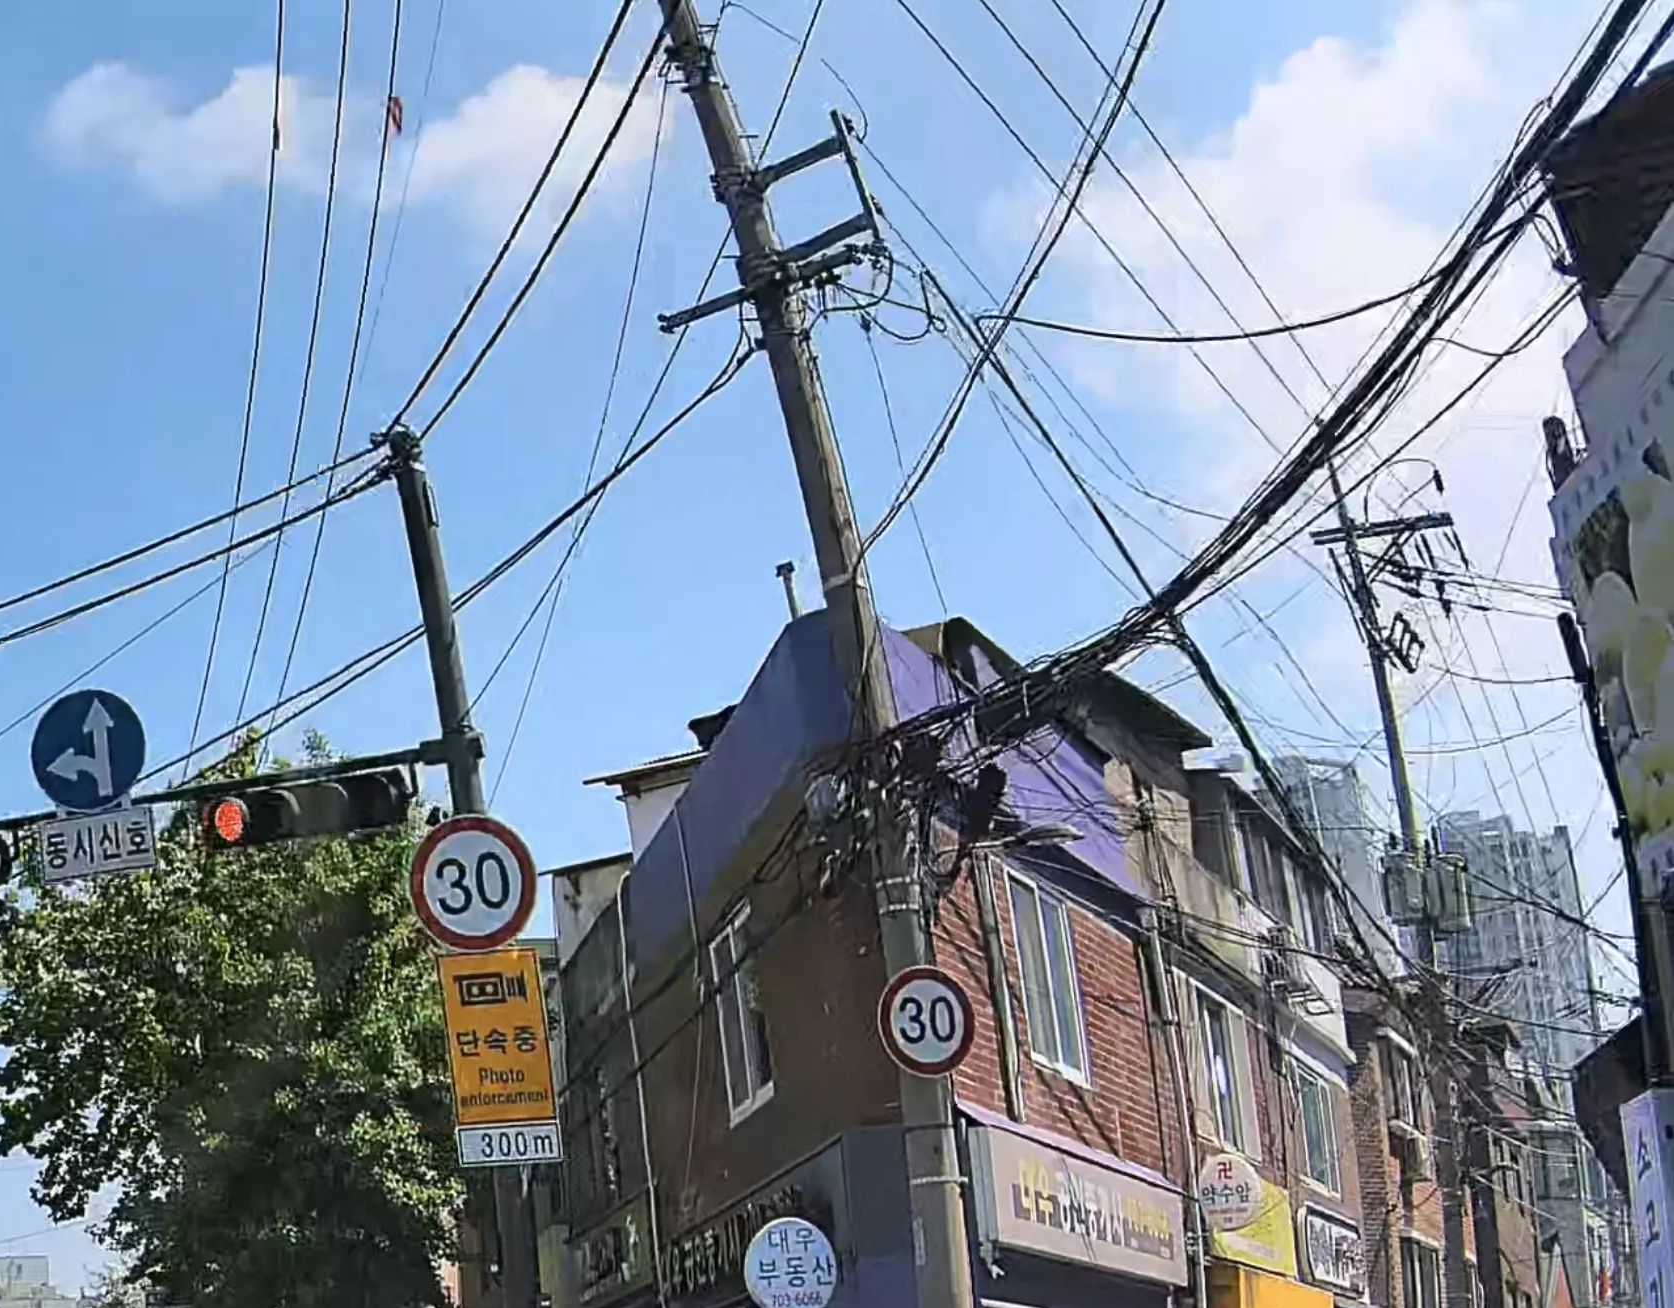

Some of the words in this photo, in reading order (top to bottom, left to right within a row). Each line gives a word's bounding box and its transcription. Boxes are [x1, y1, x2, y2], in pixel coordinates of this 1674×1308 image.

[46, 821, 150, 869] 동시신호
[436, 852, 510, 915] 30
[899, 996, 956, 1044] 30
[456, 1025, 537, 1057] 단속중
[479, 1067, 525, 1086] Photo
[481, 1132, 553, 1158] 300m
[768, 1227, 816, 1255] 대우
[758, 1255, 834, 1288] 부동산
